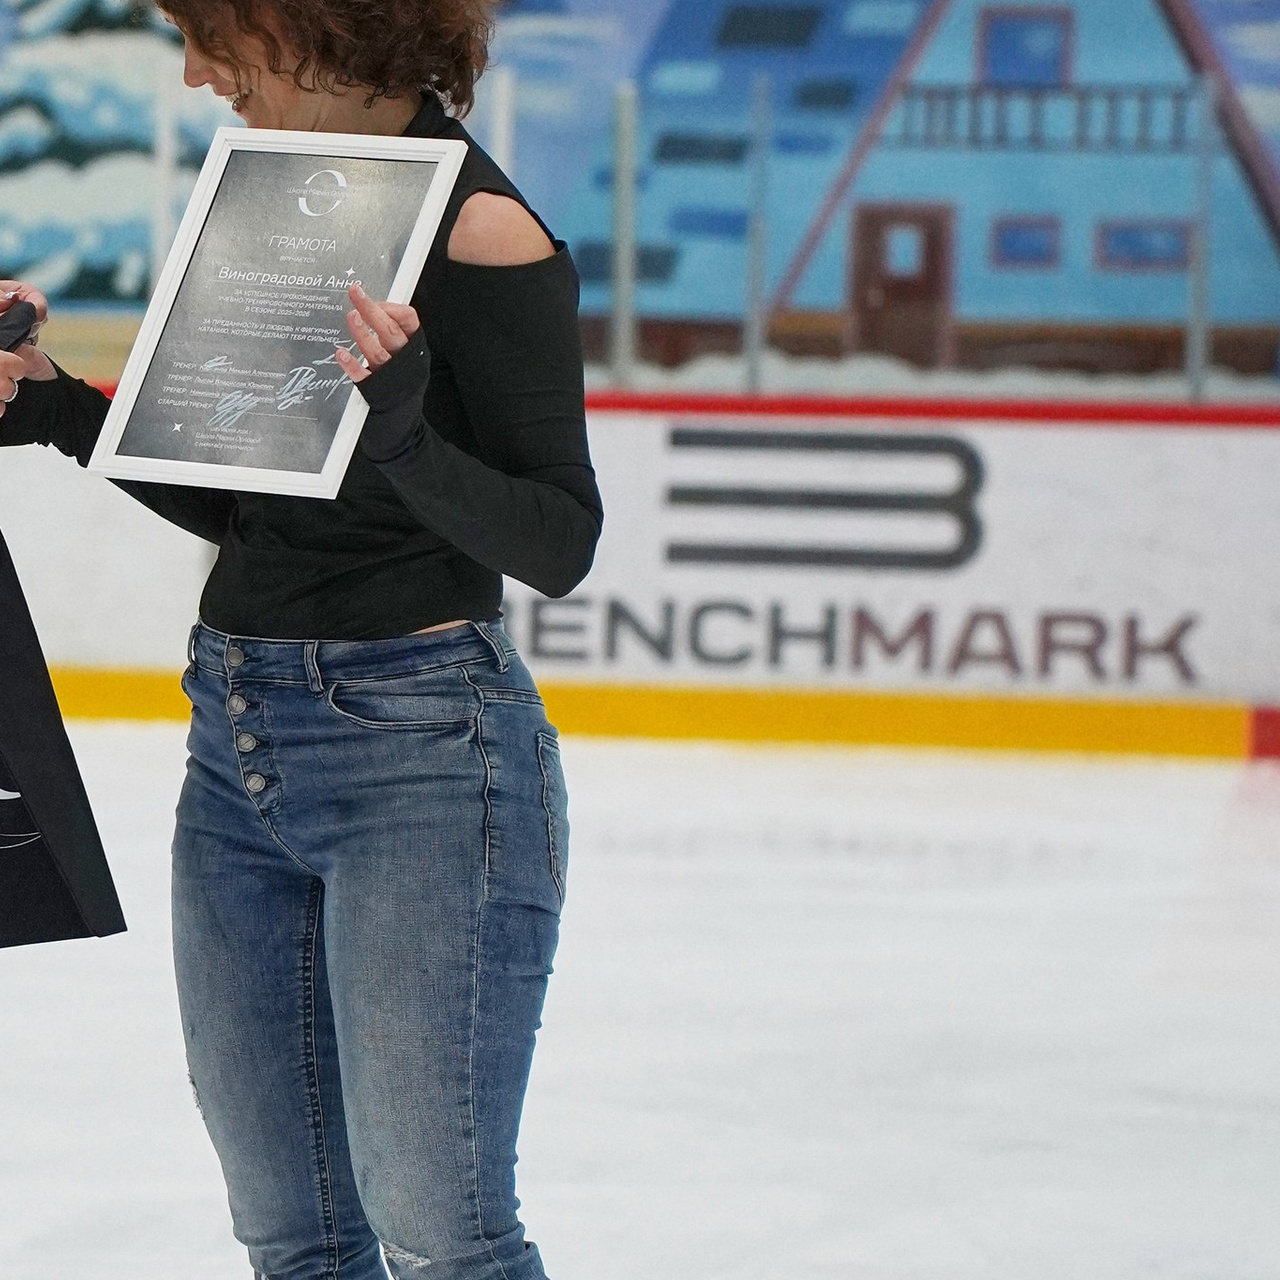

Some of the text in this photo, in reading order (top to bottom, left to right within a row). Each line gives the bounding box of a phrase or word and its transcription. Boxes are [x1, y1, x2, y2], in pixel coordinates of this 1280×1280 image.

[268, 235, 336, 252] ГРАМОТА
[218, 266, 362, 288] Виноградовой Анне
[218, 296, 343, 311] УЧЕБНО-ТРЕНИРОВОЧНОГО МАТЕРИАЛА
[244, 290, 279, 299] УСПЕШНОЕ
[280, 292, 330, 302] ПРОХОЖДЕНИЕ
[251, 307, 276, 315] СЕЗОНЕ
[212, 319, 259, 329] ПРЕДАННОСТЬ
[266, 324, 294, 332] ЛЮБОВЬ
[300, 327, 341, 336] ФИГУРНОМУ
[231, 329, 261, 337] КОТОРЫЕ
[262, 331, 290, 340] ДЕЛАЮТ
[157, 398, 188, 407] СТАРШИЙ
[504, 596, 1208, 688] ENCHMARK
